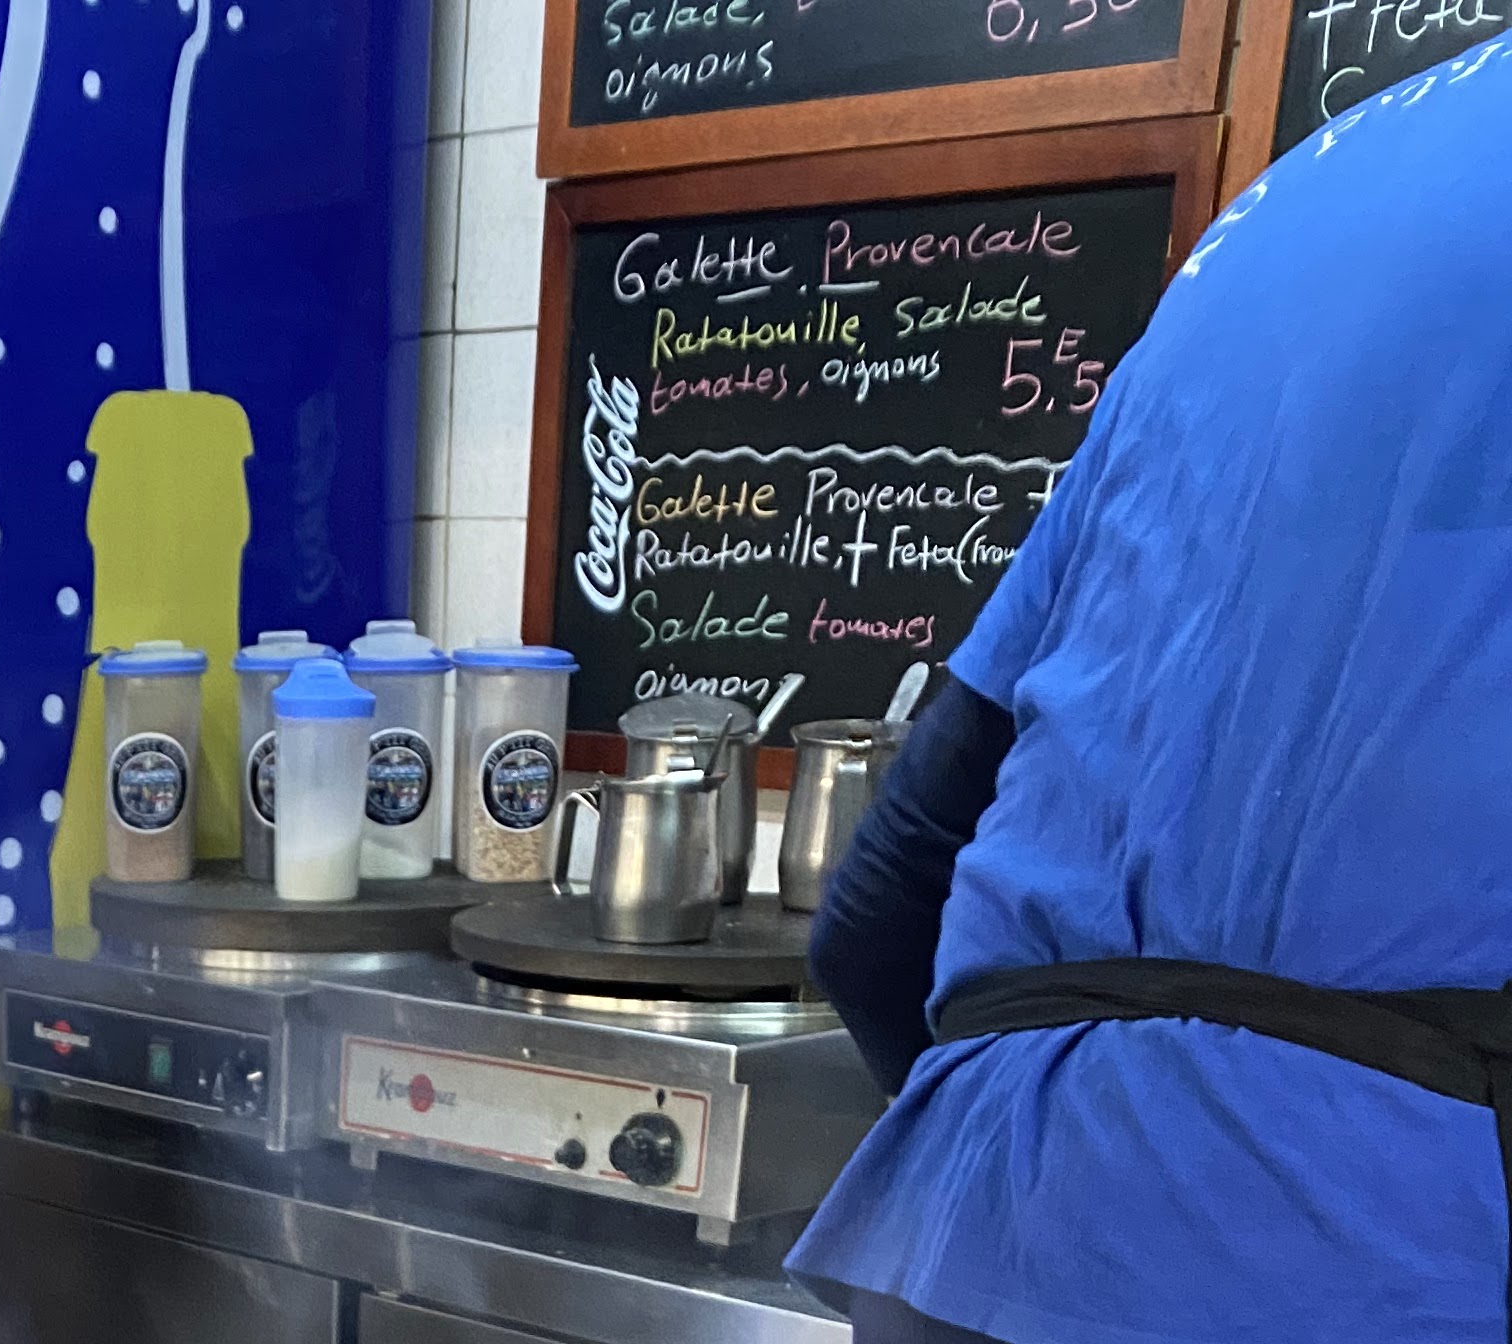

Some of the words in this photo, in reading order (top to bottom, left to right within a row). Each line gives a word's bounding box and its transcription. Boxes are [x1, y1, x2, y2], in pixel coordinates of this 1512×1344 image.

[614, 231, 794, 302] Galette
[895, 274, 1048, 339] Salade
[637, 473, 780, 526] Galette
[631, 590, 790, 649] Salade
[634, 662, 778, 701] oignon
